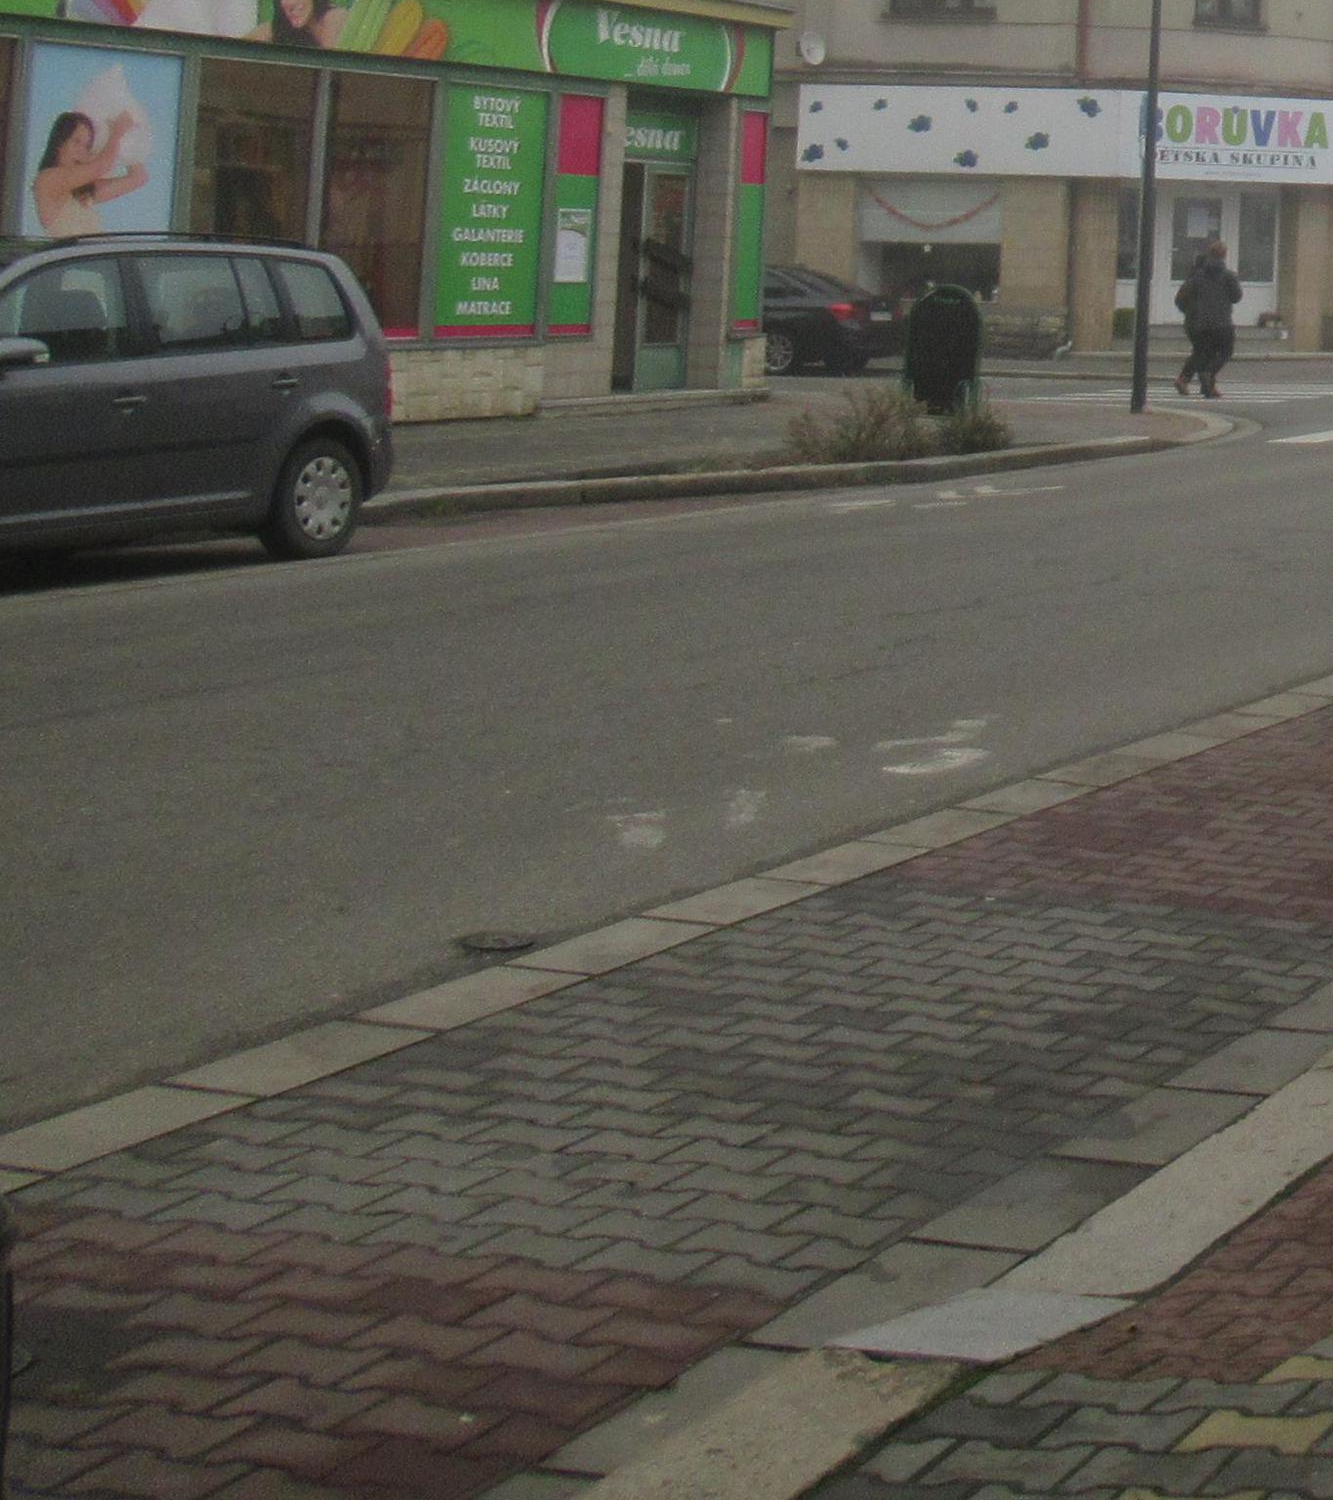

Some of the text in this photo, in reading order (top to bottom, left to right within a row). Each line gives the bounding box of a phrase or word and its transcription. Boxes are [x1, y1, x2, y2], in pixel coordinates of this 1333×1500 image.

[597, 8, 687, 53] Vesna
[479, 112, 515, 129] TEXTIL
[625, 126, 686, 150] esna
[476, 153, 513, 170] TEXTIL
[1229, 152, 1318, 168] SKUPINA
[463, 175, 521, 196] ZÁCLONY
[452, 227, 525, 243] GALANTERIE
[460, 251, 514, 267] KOBERCE
[456, 300, 513, 315] MATRACE
